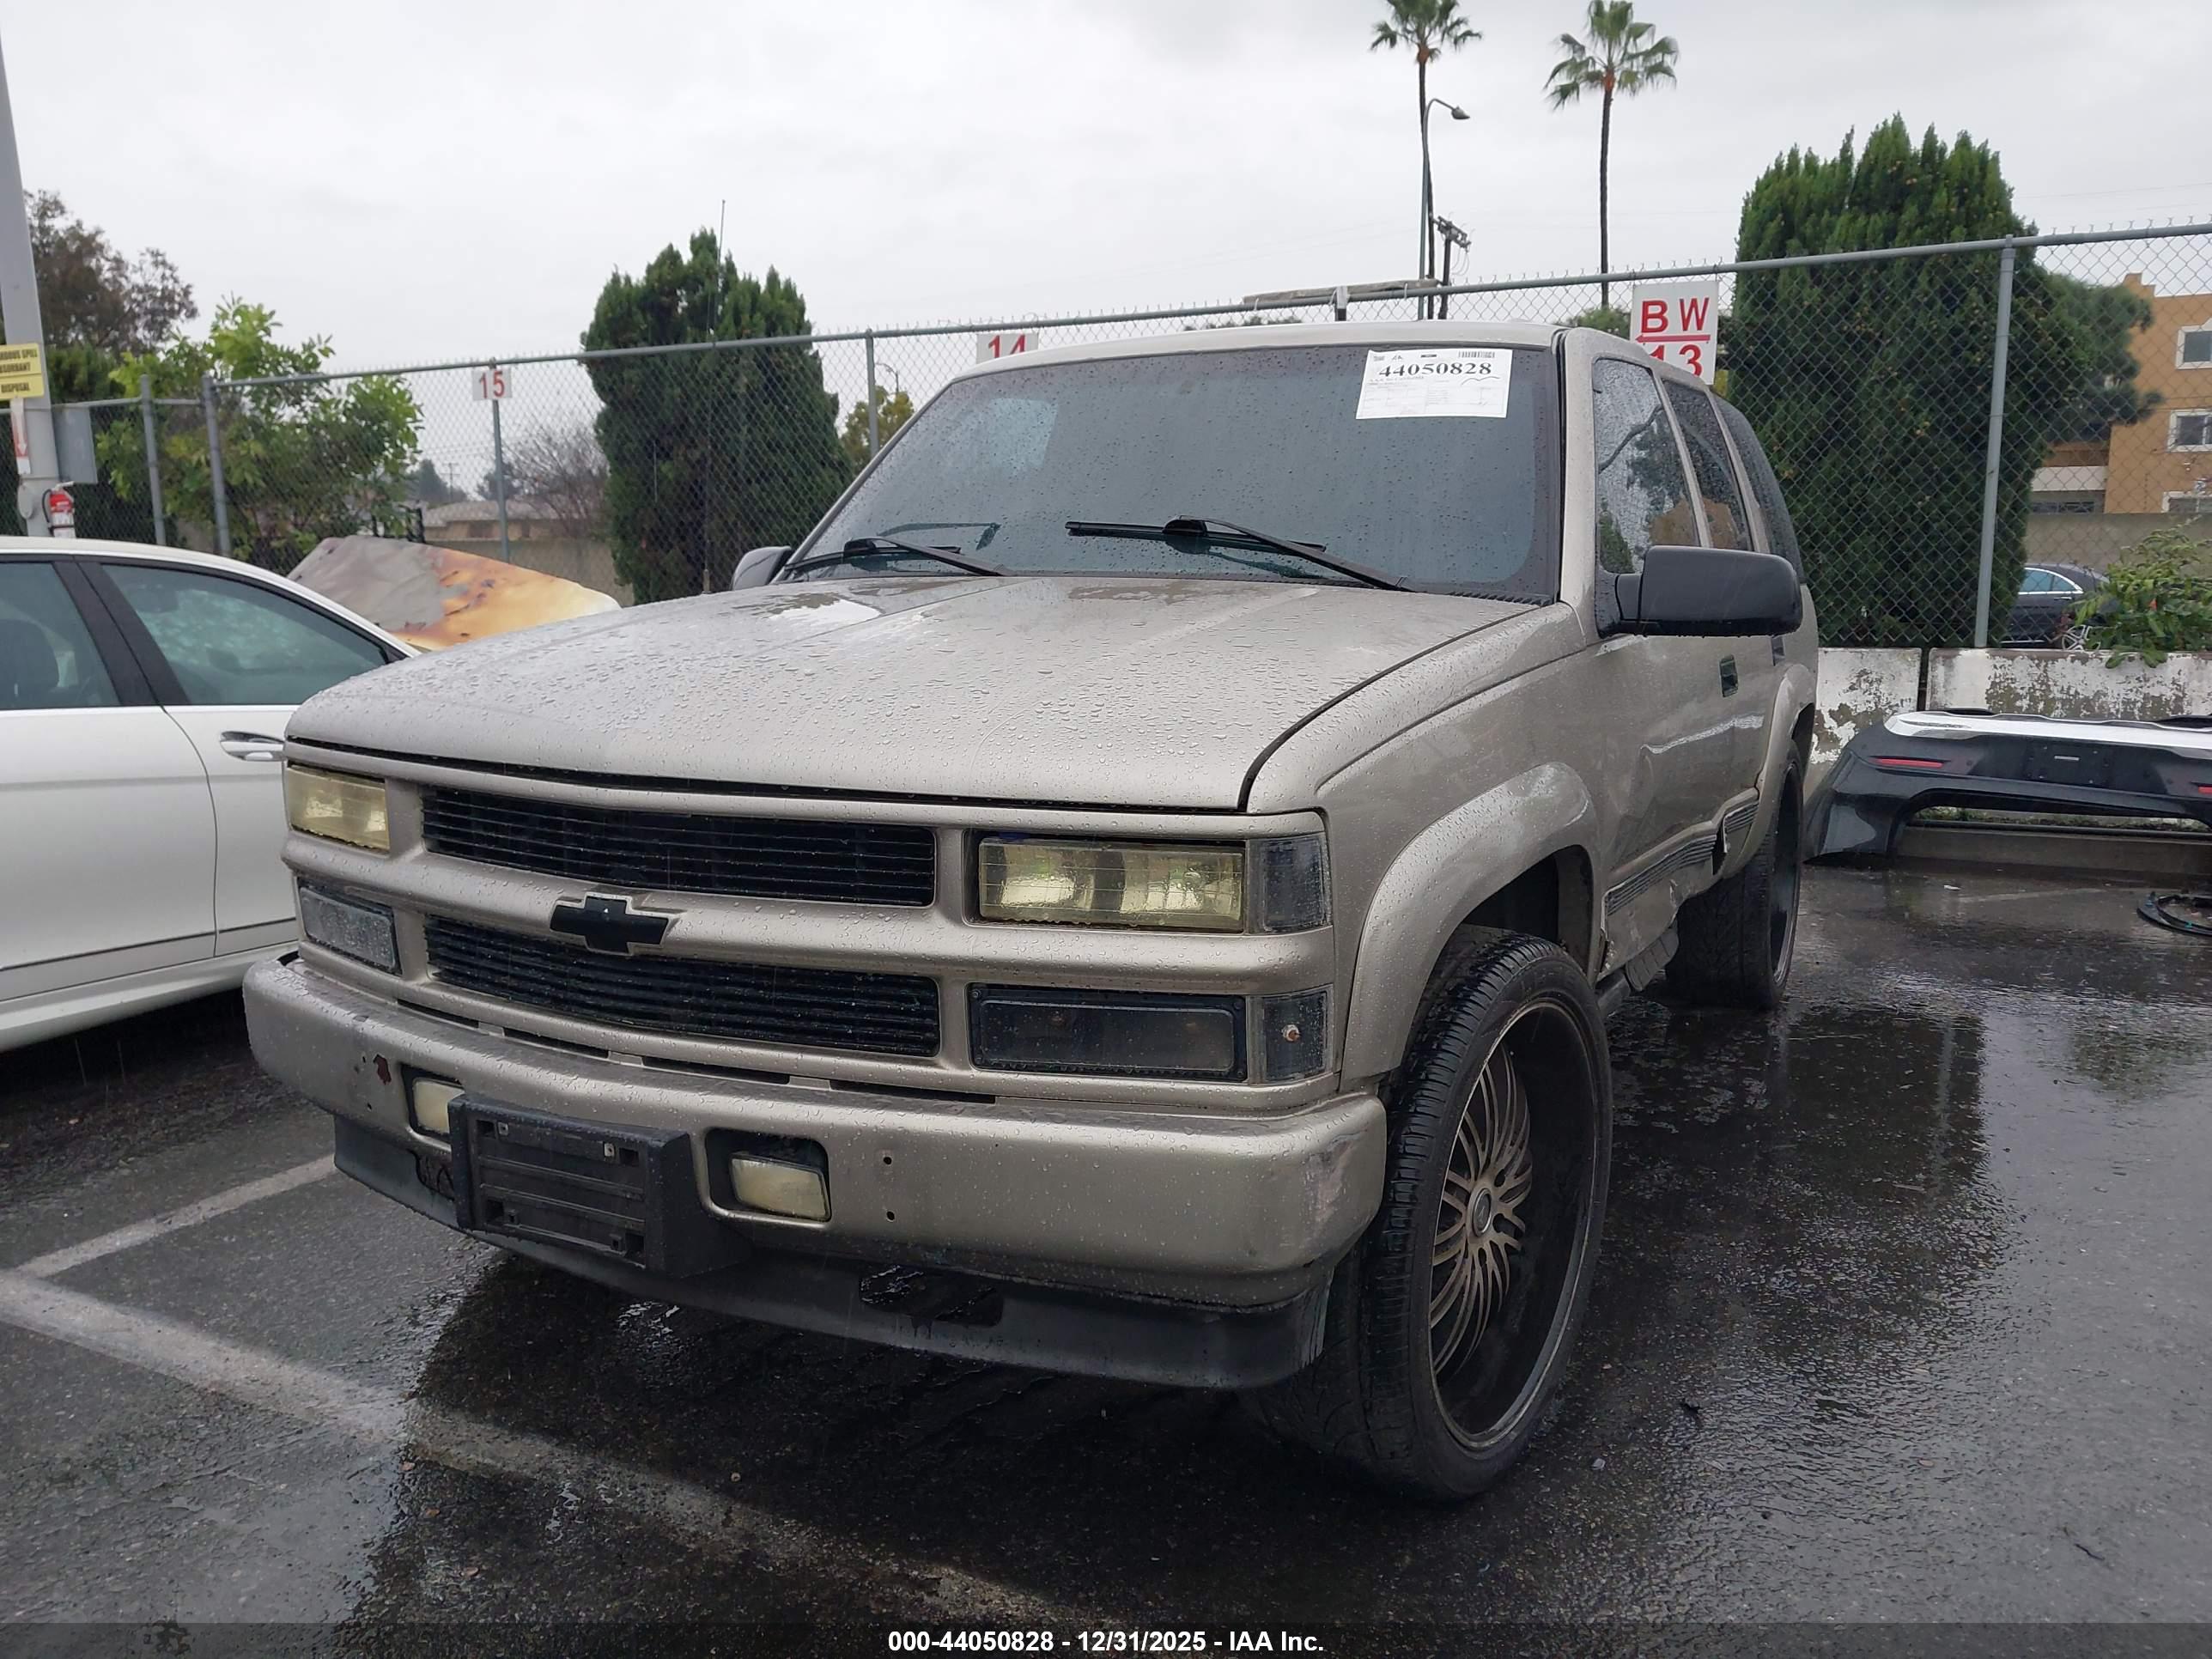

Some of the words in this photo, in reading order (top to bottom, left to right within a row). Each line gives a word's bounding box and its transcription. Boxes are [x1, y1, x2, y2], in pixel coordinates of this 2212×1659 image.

[988, 333, 1026, 359] 14
[1379, 362, 1492, 376] 44050828
[1, 383, 30, 392] DISPOSAL
[478, 371, 506, 399] 15
